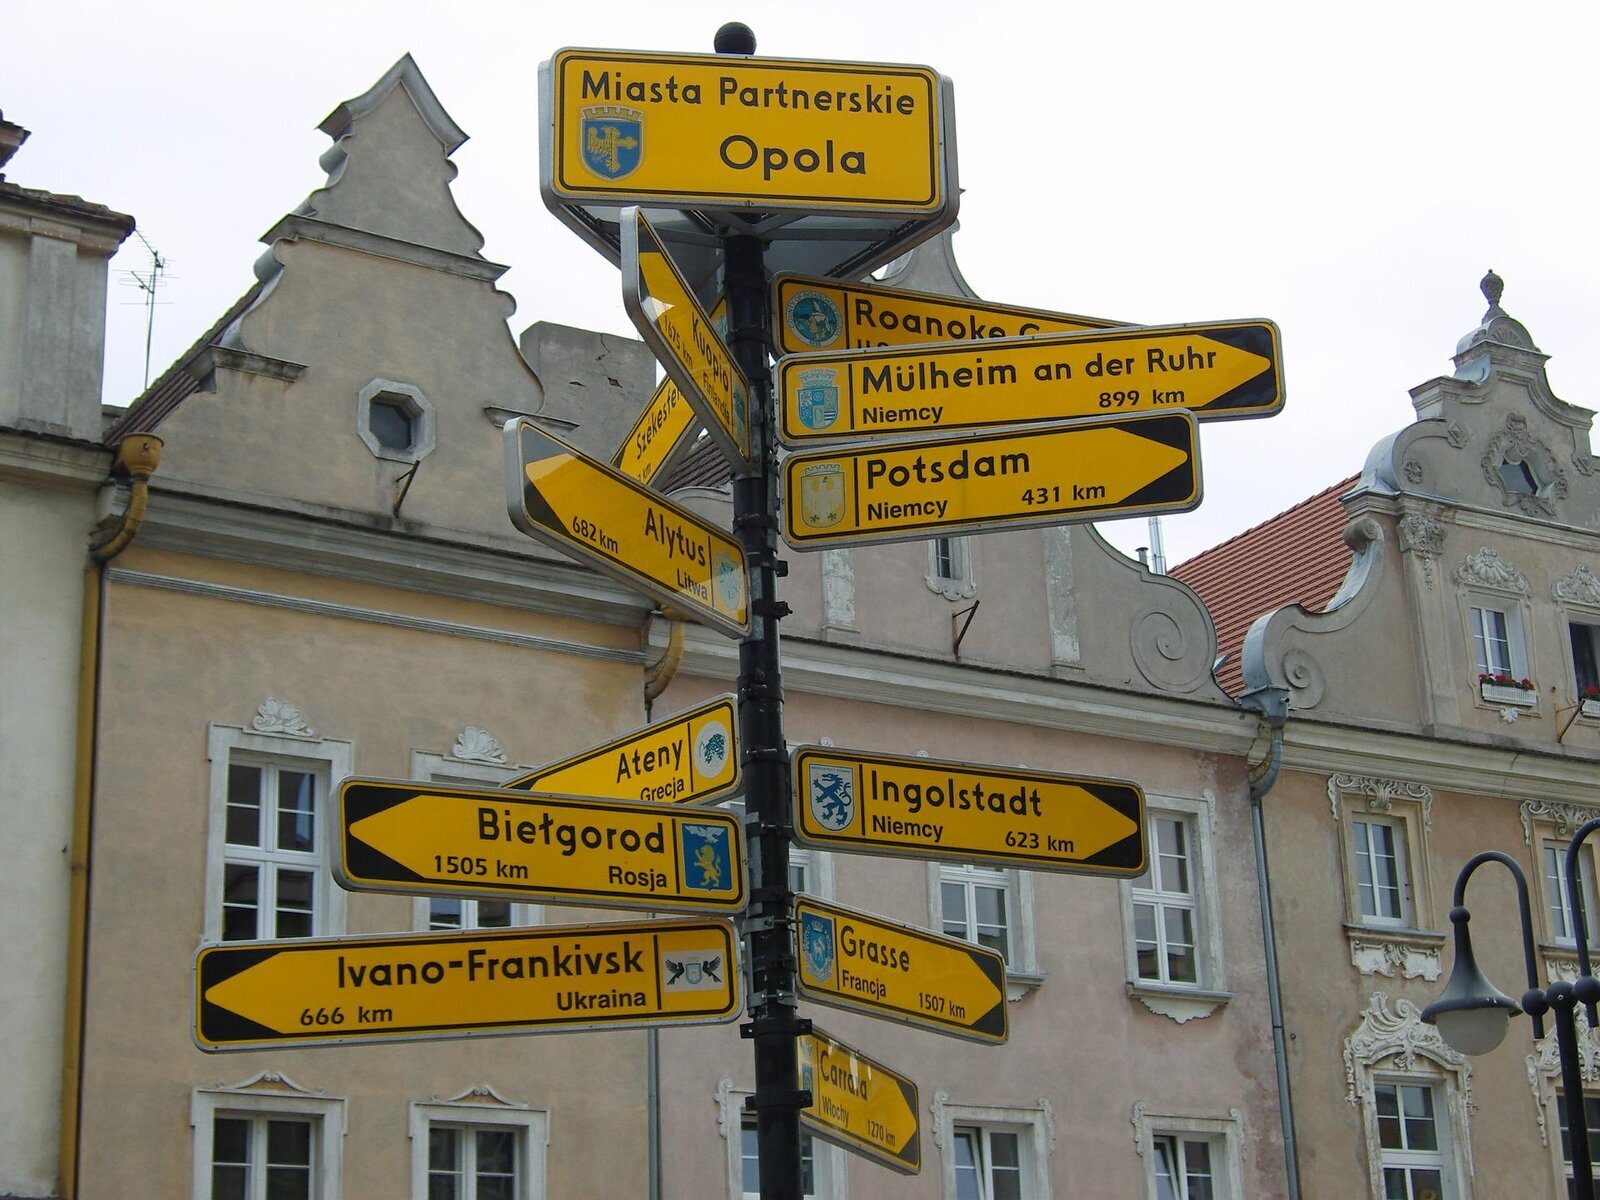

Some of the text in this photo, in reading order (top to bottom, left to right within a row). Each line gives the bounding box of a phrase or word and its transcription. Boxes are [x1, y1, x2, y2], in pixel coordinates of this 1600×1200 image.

[582, 70, 914, 115] Miasta Partnerskie
[720, 135, 866, 181] Opola
[855, 298, 1006, 340] Roanoke
[683, 343, 693, 370] km
[692, 312, 729, 392] Kuopio
[863, 346, 1217, 395] Mülheim an der Ruhr
[703, 371, 731, 426] Finlandia
[1099, 387, 1185, 408] 899 km
[863, 404, 943, 425] Niemcy
[868, 450, 1030, 490] Potsdam
[867, 499, 947, 521] Niemcy
[1022, 484, 1106, 506] 431 km
[572, 515, 618, 554] 682 km
[644, 507, 706, 567] Alytus
[676, 568, 708, 601] Litwa
[616, 739, 684, 784] Ateny
[641, 777, 685, 801] Grecja
[872, 770, 1042, 817] Ingolstadt
[478, 807, 665, 857] Biełgorod
[872, 815, 943, 843] Niemcy
[1005, 831, 1074, 853] 623 km
[433, 855, 528, 880] 1505 km
[608, 866, 668, 892] Rosja
[338, 941, 644, 989] Ivano-Frankivsk
[841, 926, 910, 973] Grasse
[556, 989, 647, 1011] Ukraina
[842, 970, 886, 1000] Francja
[300, 1006, 393, 1026] 666 km
[918, 992, 965, 1019] 1507 km
[868, 1120, 896, 1147] 1270 km
